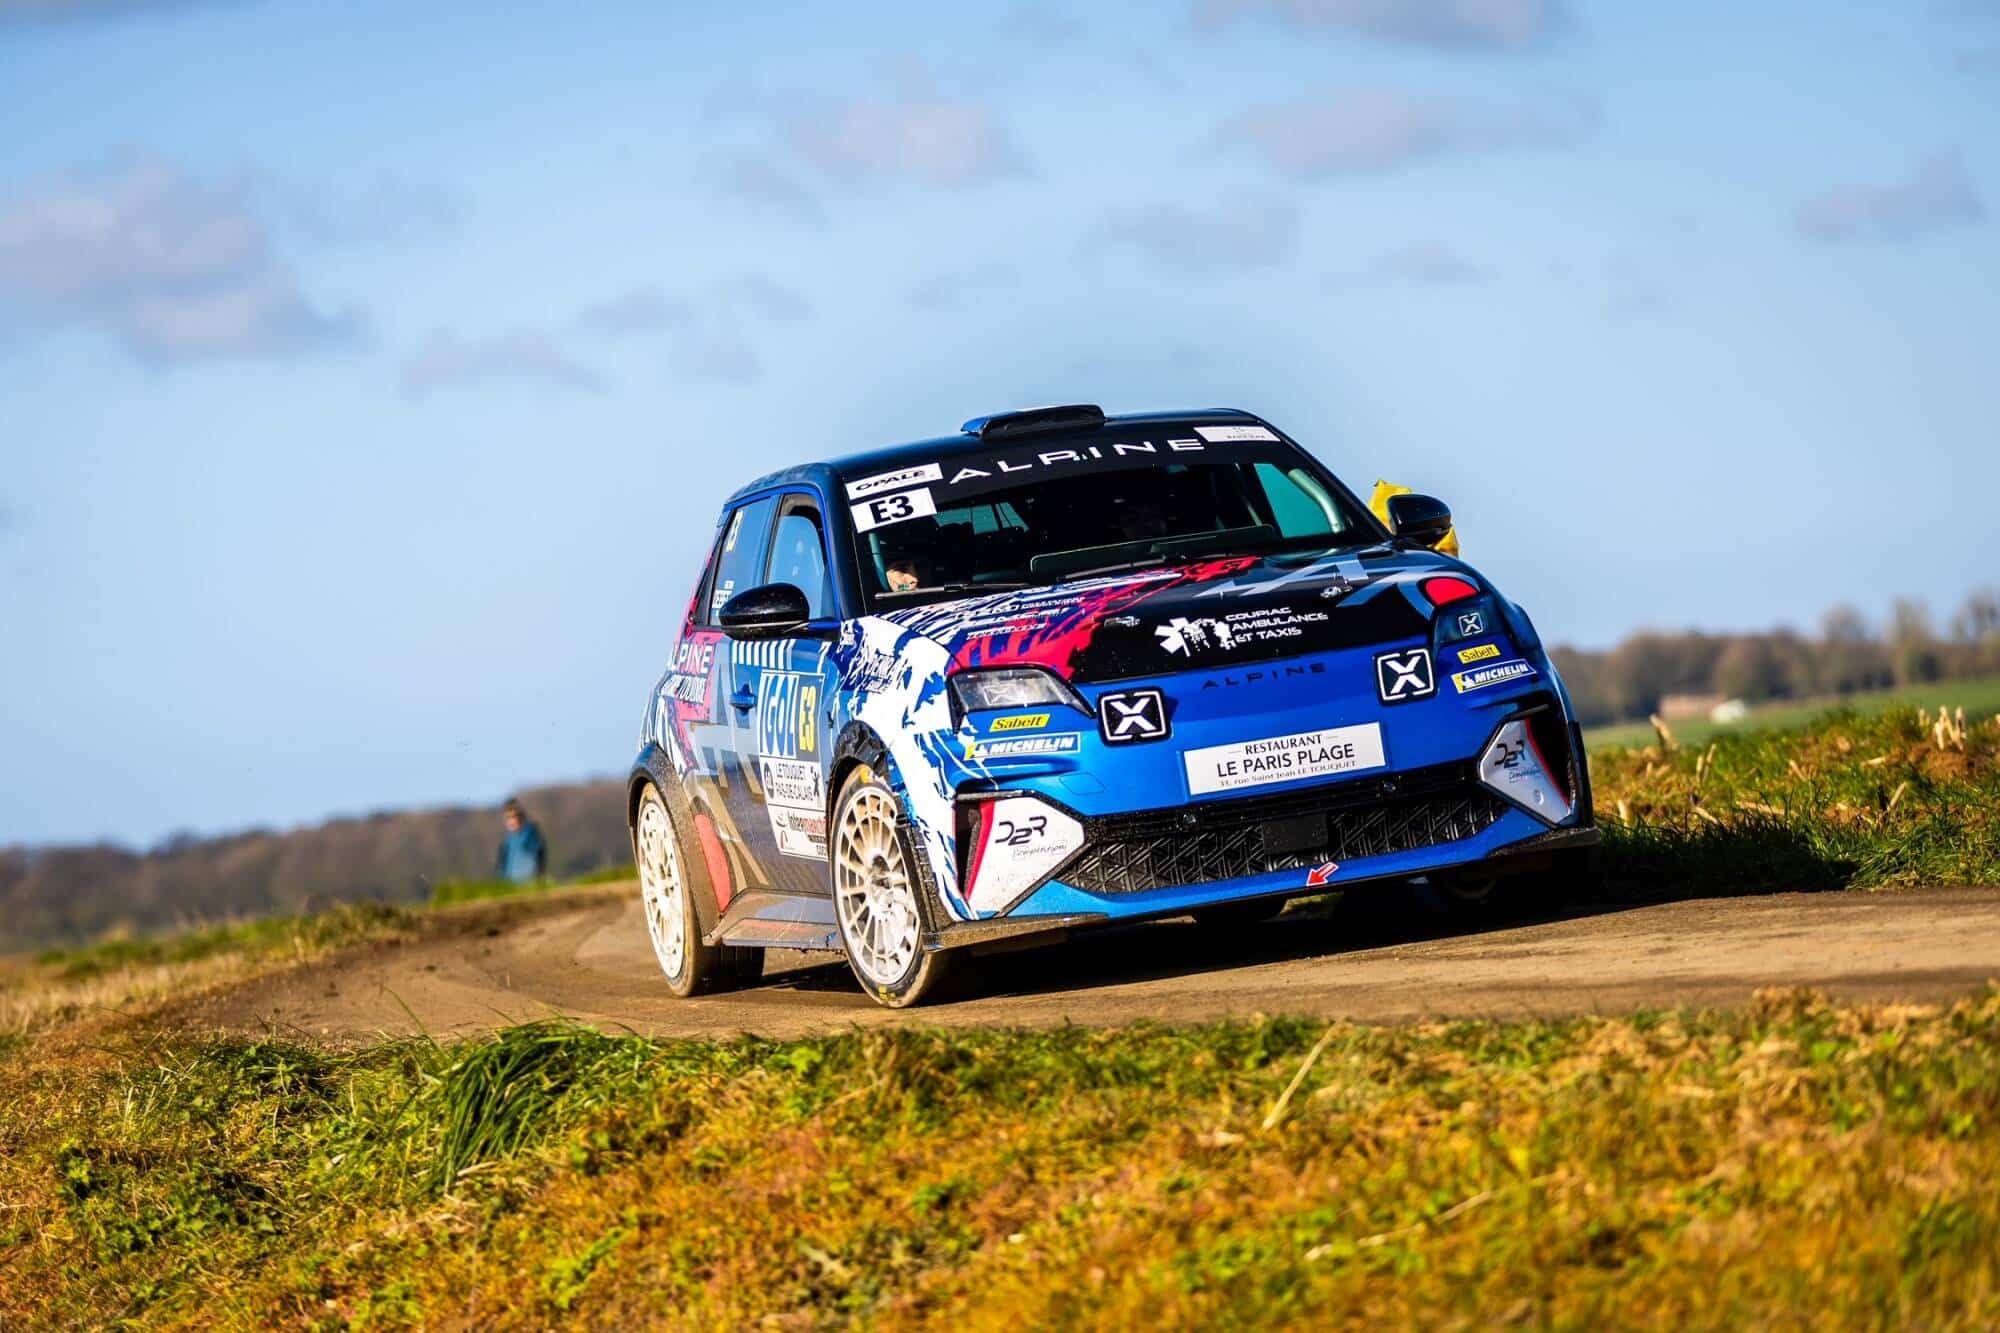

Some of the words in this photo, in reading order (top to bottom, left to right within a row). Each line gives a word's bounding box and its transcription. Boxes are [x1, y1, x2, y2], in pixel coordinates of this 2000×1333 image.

[949, 438, 1205, 485] ALPINE
[855, 469, 926, 491] OPALE
[868, 495, 914, 524] E3
[1225, 606, 1292, 622] COUPIAC
[1231, 612, 1329, 632] AMBULANCE
[1235, 632, 1252, 643] ET
[1256, 626, 1303, 640] TAXIS
[1461, 646, 1496, 662] Sabelt
[1202, 663, 1326, 689] ALPINE
[1473, 660, 1529, 684] MICHELIN
[800, 685, 816, 753] E3
[994, 715, 1043, 731] Sabelt
[990, 737, 1075, 754] MICHELIN
[1245, 734, 1323, 755] RESTAURANT
[1216, 761, 1238, 777] LE
[1243, 752, 1292, 774] PARIS
[1297, 743, 1355, 765] PLAGE
